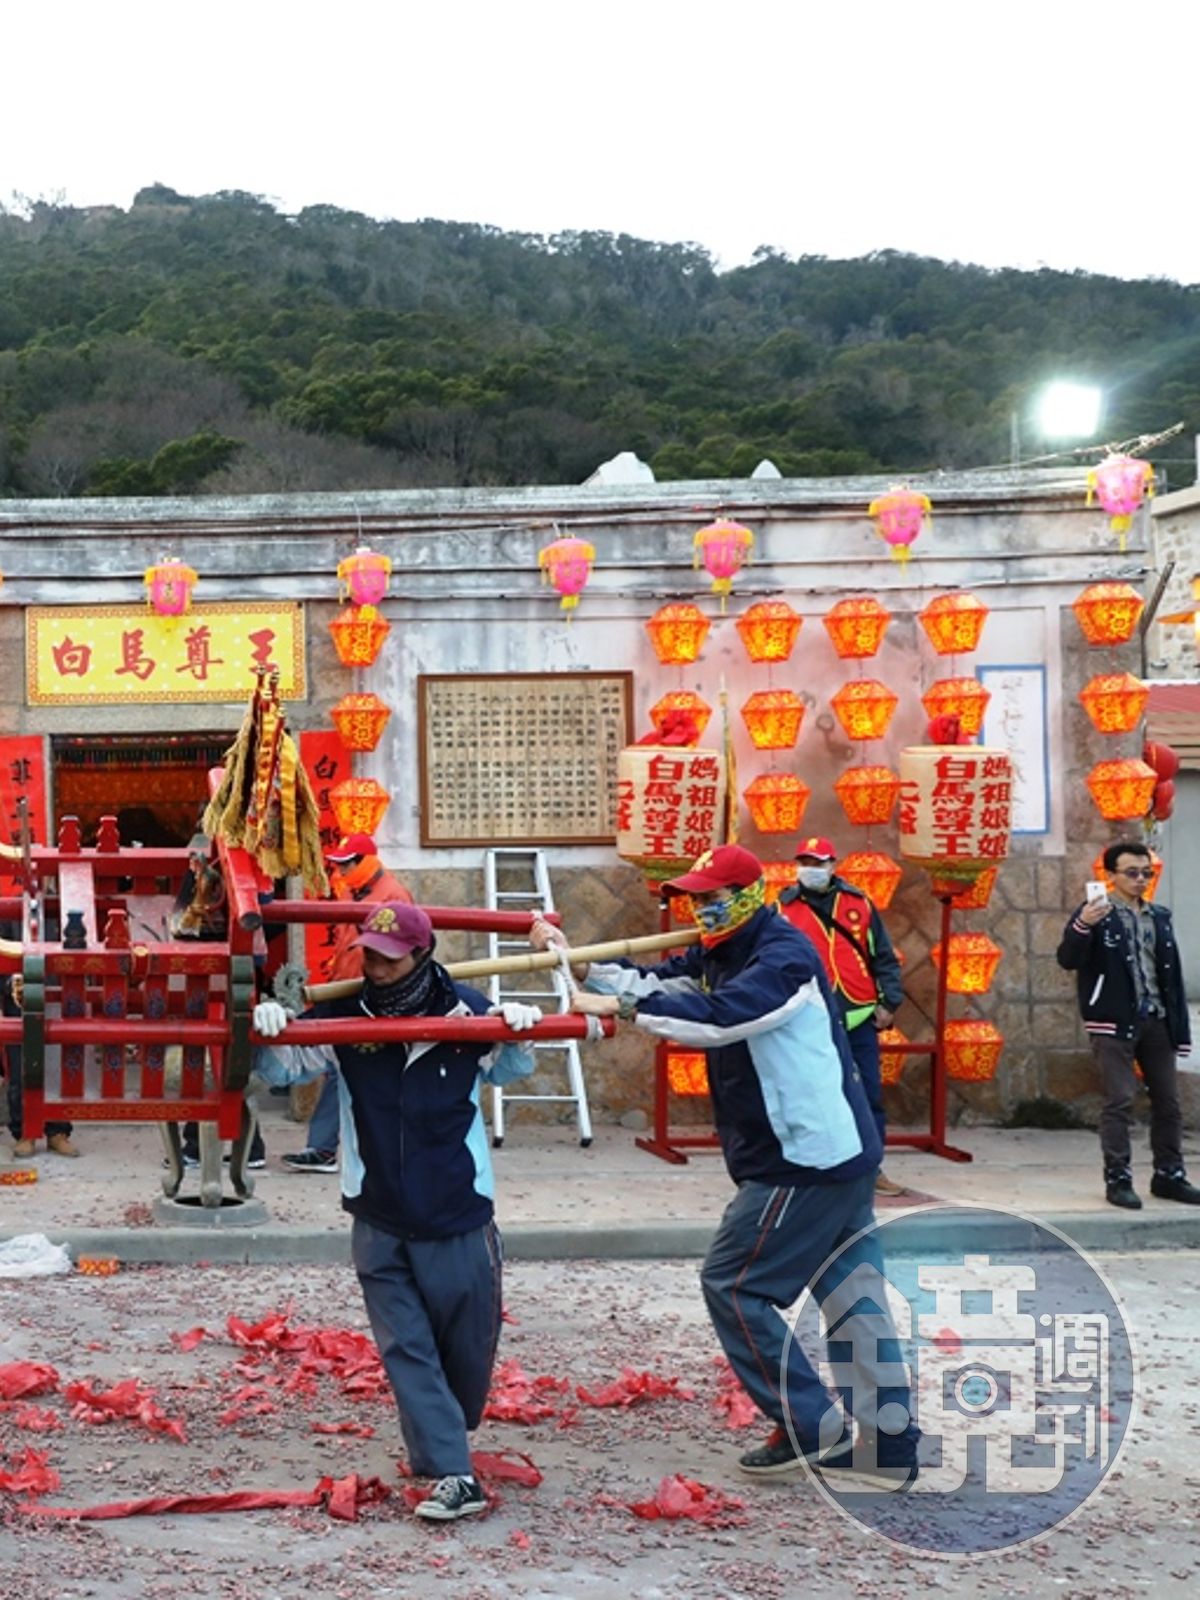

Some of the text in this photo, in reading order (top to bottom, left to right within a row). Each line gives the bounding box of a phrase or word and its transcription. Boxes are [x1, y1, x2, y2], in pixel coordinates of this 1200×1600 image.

[52, 625, 280, 681] 白馬尊王
[642, 754, 685, 857] 白馬尊王
[682, 756, 719, 856] 媽祖娘娘
[931, 755, 977, 859] 白馬尊王
[977, 756, 1013, 857] 媽祖娘娘
